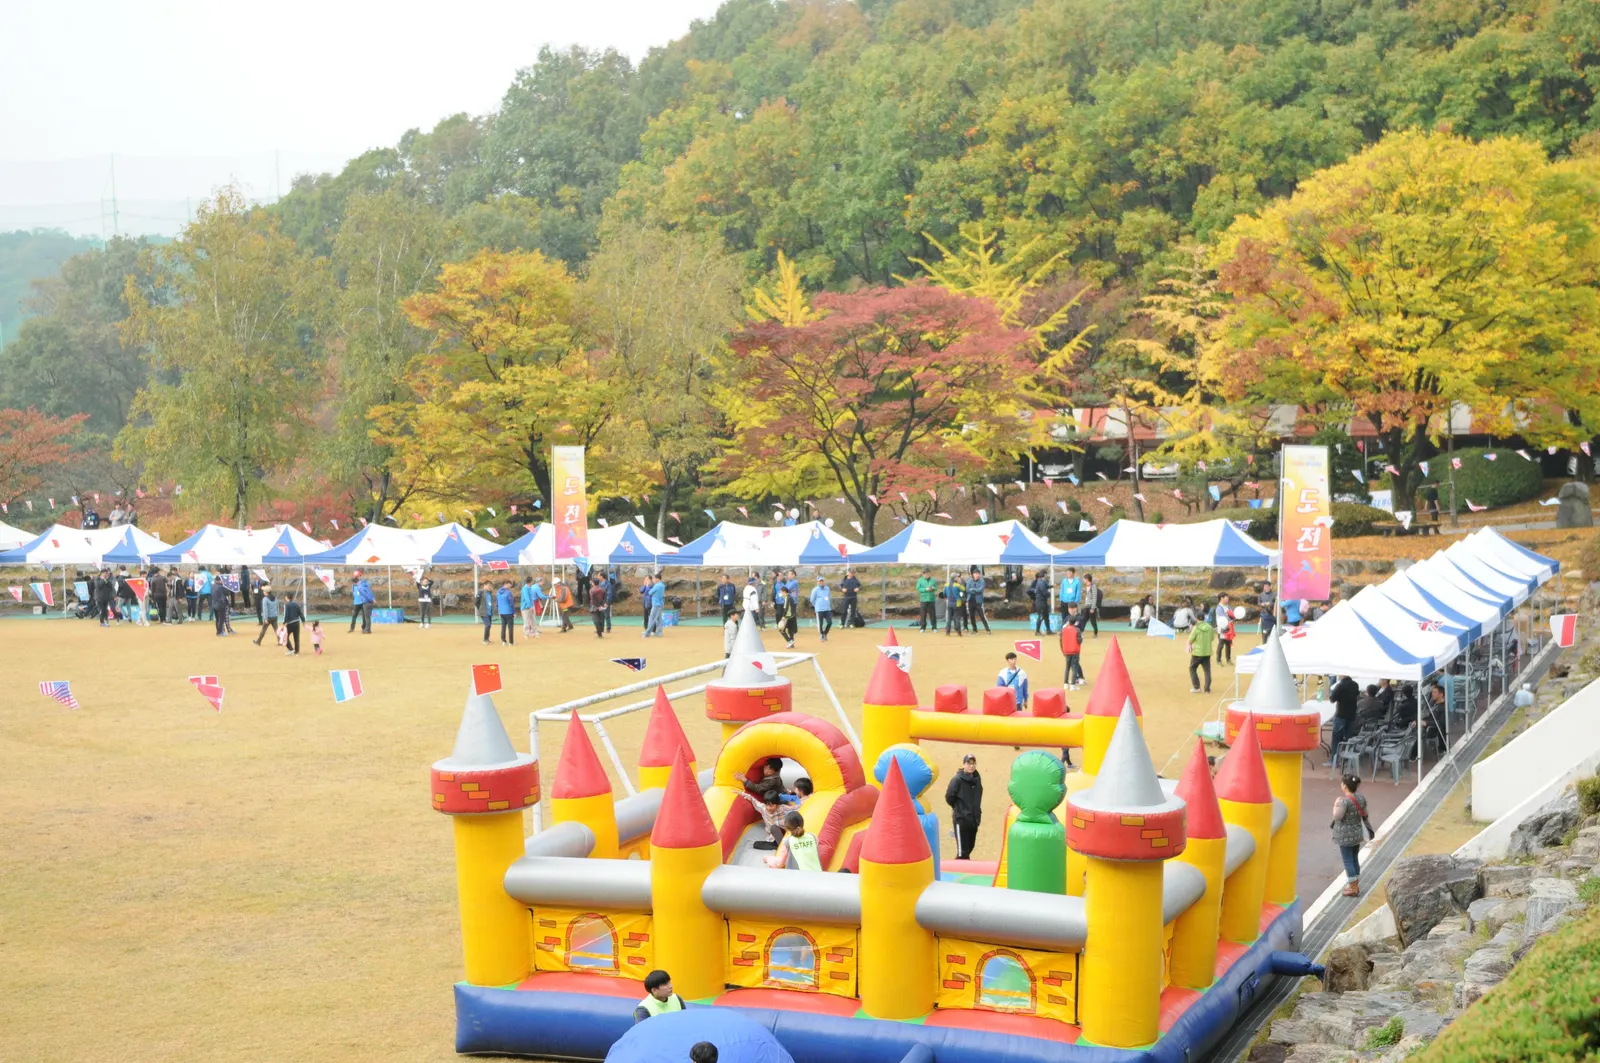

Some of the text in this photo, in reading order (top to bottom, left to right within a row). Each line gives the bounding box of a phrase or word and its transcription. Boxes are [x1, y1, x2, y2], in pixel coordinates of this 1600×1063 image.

[561, 476, 581, 524] 도전
[1296, 488, 1321, 553] 도전
[794, 841, 813, 850] STAFF
